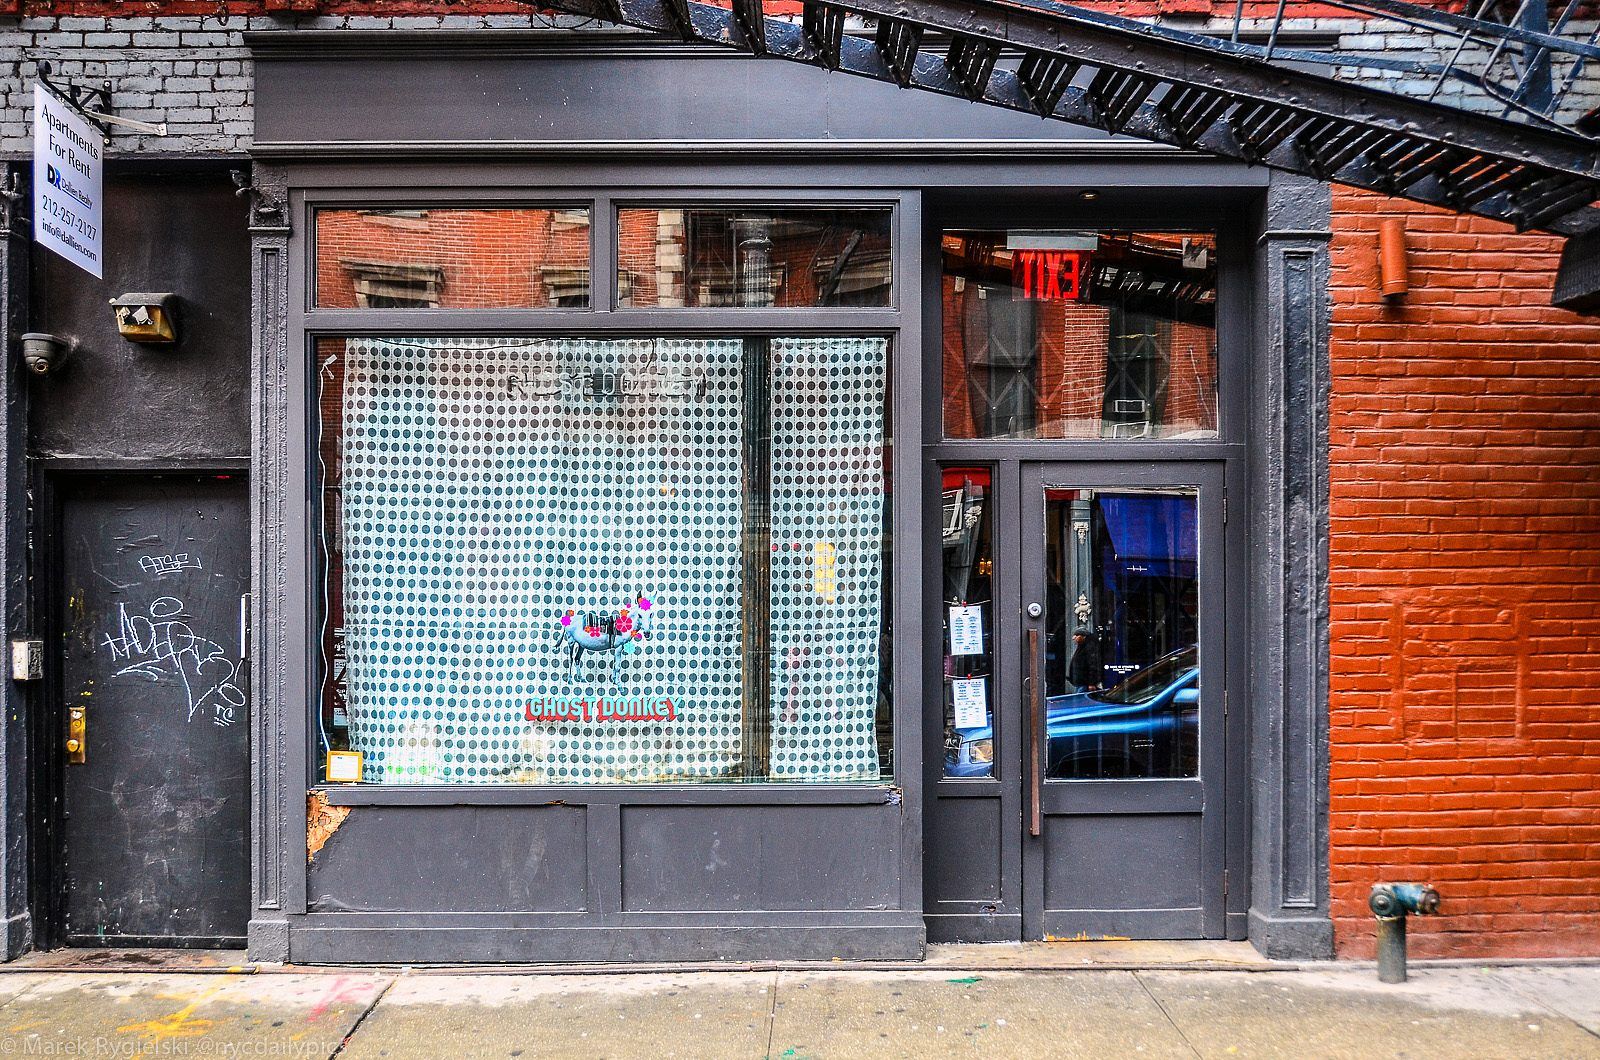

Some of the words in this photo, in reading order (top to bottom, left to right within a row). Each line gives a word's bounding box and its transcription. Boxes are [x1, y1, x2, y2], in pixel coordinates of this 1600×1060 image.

[41, 104, 99, 160] Apartments
[47, 163, 62, 191] DR
[49, 134, 66, 160] For
[68, 149, 92, 180] Rent
[42, 195, 97, 241] 212-257-2127
[42, 218, 97, 262] info@dallien.com
[525, 697, 597, 722] GHOST
[597, 697, 684, 721] DONKEY
